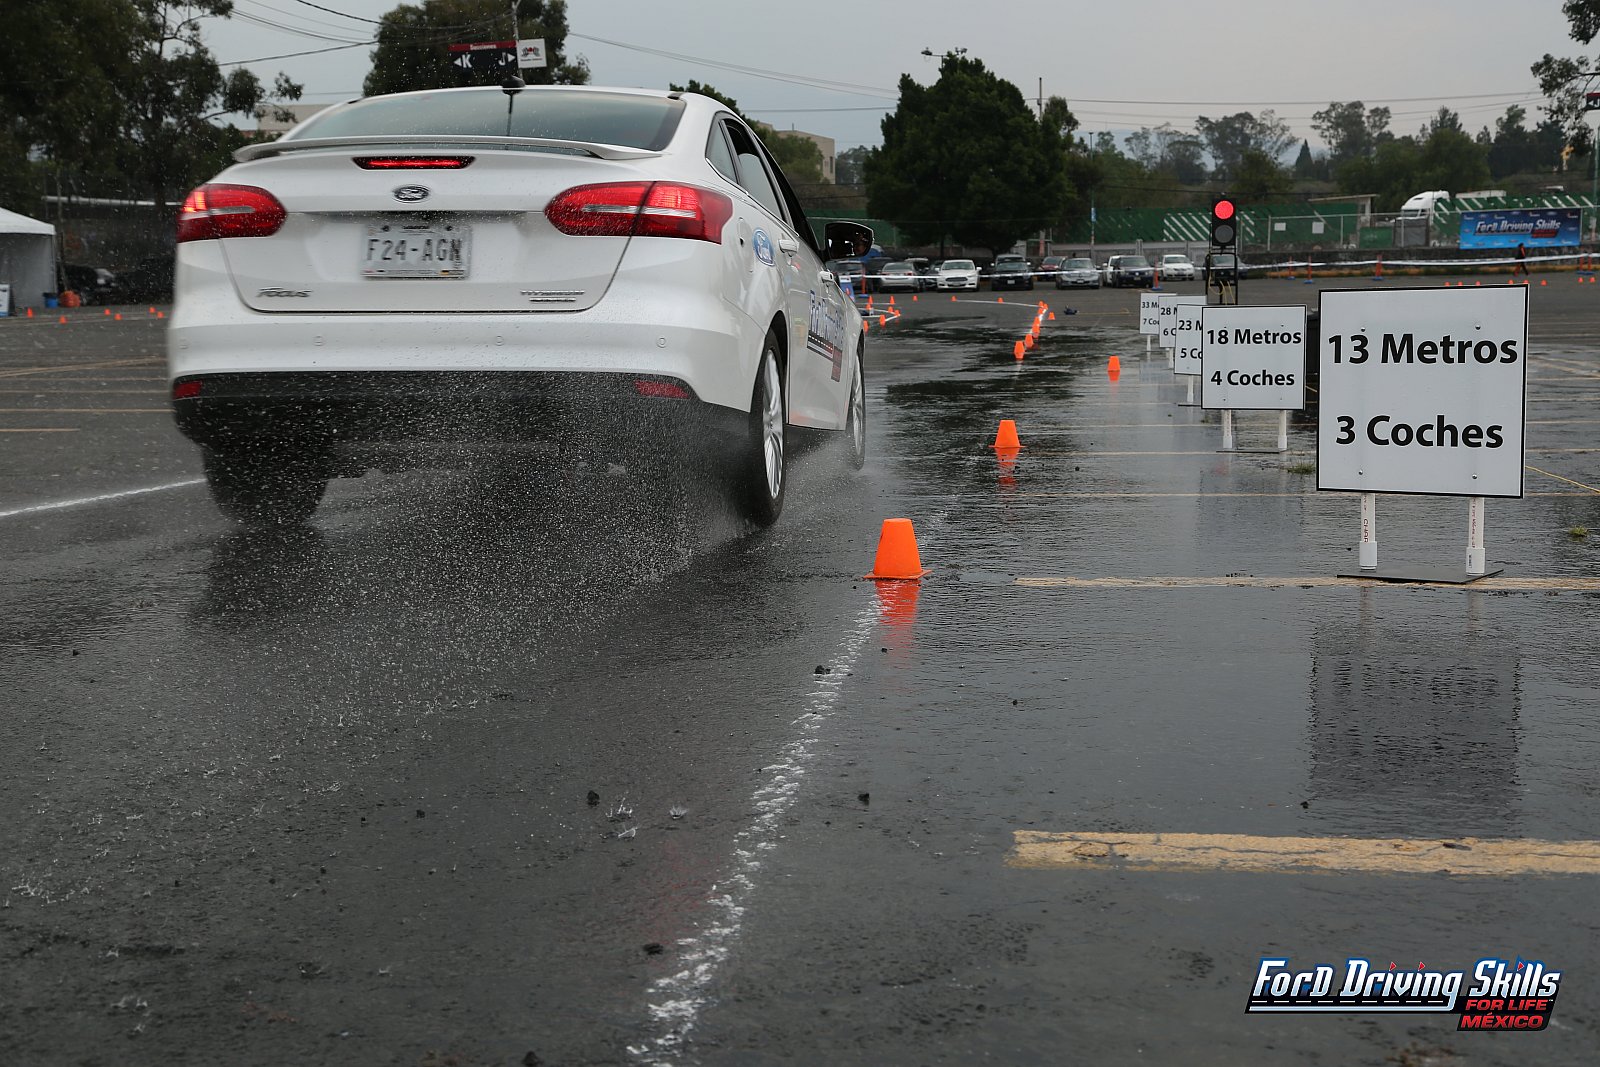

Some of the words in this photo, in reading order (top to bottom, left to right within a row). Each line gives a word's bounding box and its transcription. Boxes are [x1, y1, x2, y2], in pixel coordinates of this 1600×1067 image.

[462, 54, 472, 68] K
[499, 52, 506, 66] J
[1160, 307, 1172, 315] 28
[1163, 328, 1169, 336] 6
[1178, 320, 1192, 331] 23
[1207, 329, 1229, 345] 18
[1234, 329, 1302, 345] Metros
[1180, 348, 1187, 358] 5
[1328, 334, 1369, 364] 13
[1381, 333, 1518, 364] Metros
[1211, 371, 1222, 385] 4
[1227, 370, 1295, 386] Coches
[1336, 415, 1356, 445] 3
[1366, 415, 1504, 448] Coches
